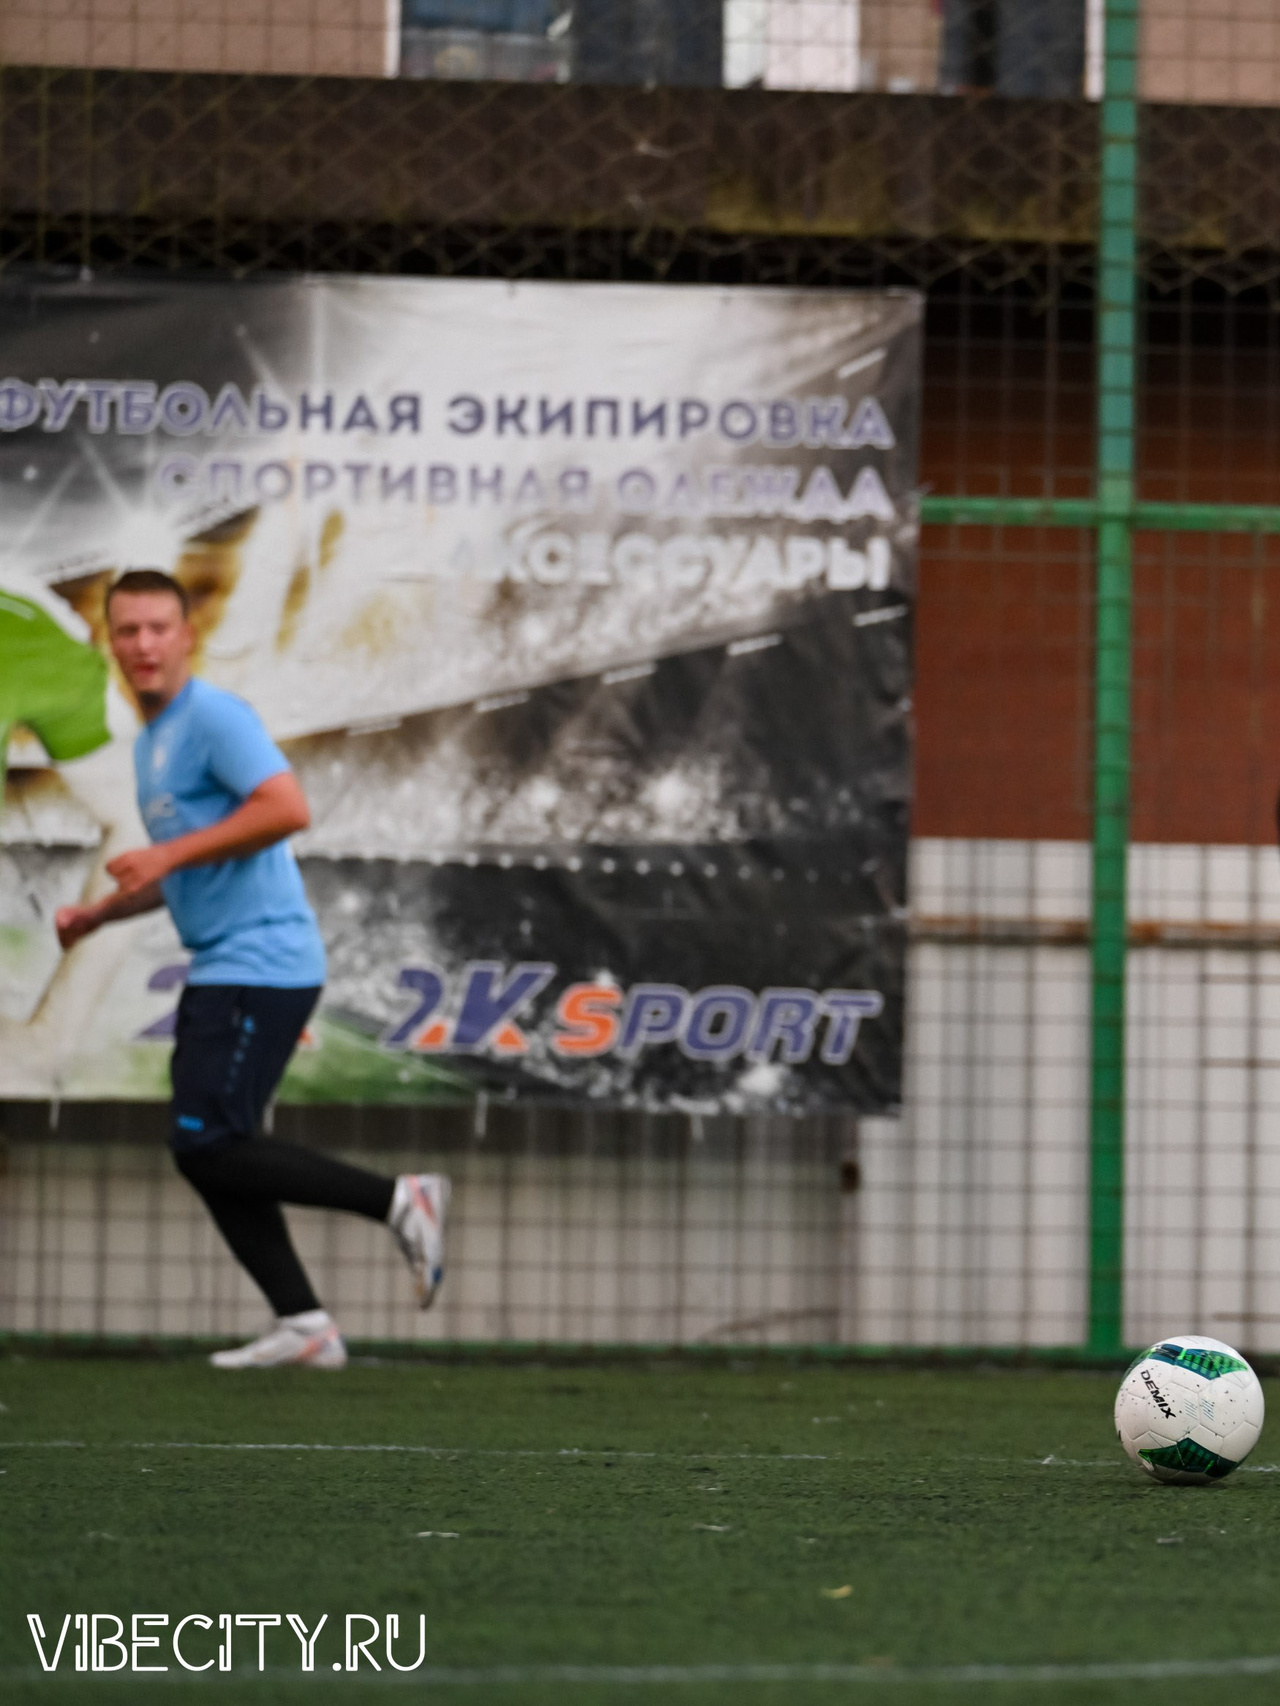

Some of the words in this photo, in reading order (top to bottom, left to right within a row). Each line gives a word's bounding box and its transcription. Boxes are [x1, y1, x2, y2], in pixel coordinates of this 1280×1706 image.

[0, 379, 422, 433] ФУТБОЛЬНАЯ
[447, 394, 893, 449] ЭКИПИРОВКА
[158, 453, 591, 508] СПОРТИВНАЯ
[615, 465, 893, 521] ОДЕЖДА
[553, 984, 881, 1062] SPORT
[1140, 1369, 1177, 1420] DEMIX
